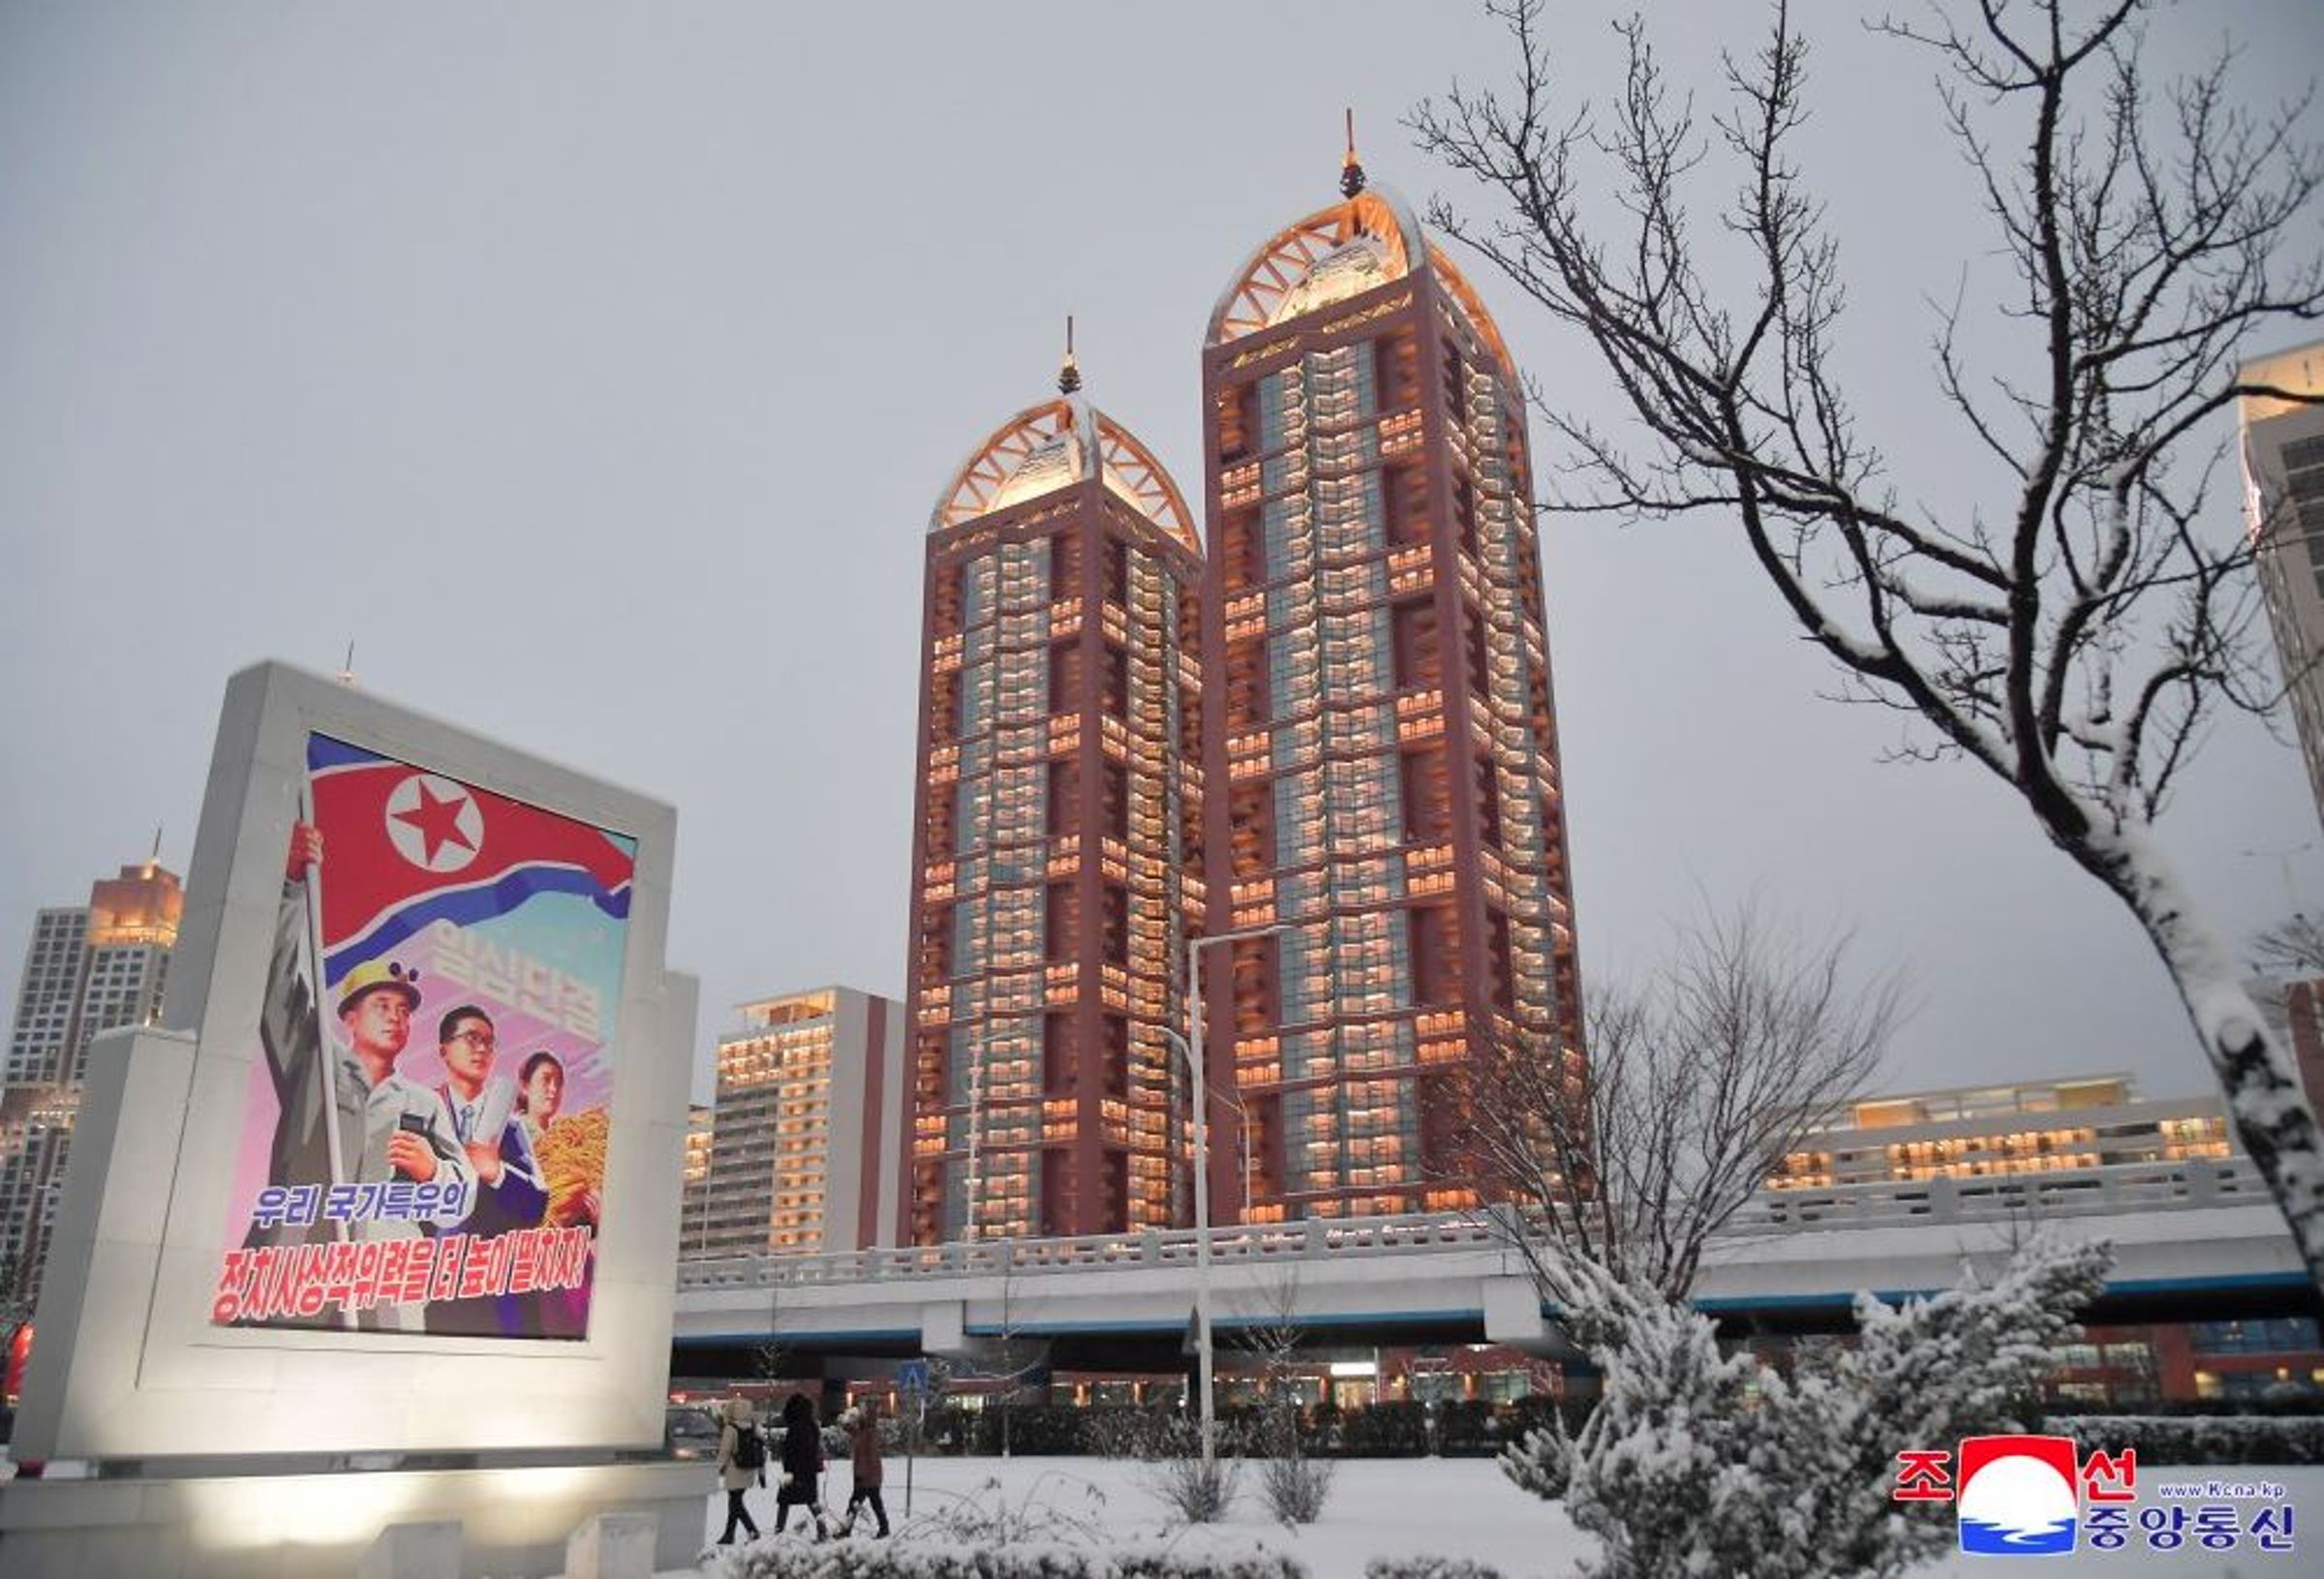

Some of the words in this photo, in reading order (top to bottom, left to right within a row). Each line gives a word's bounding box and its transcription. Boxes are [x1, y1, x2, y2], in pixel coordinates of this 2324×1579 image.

[254, 1183, 319, 1228] 우리
[325, 1180, 470, 1222] 국가특유의
[211, 1235, 437, 1324] 정치사상적위력을
[431, 1232, 466, 1300] 더
[459, 1230, 513, 1298] 높이
